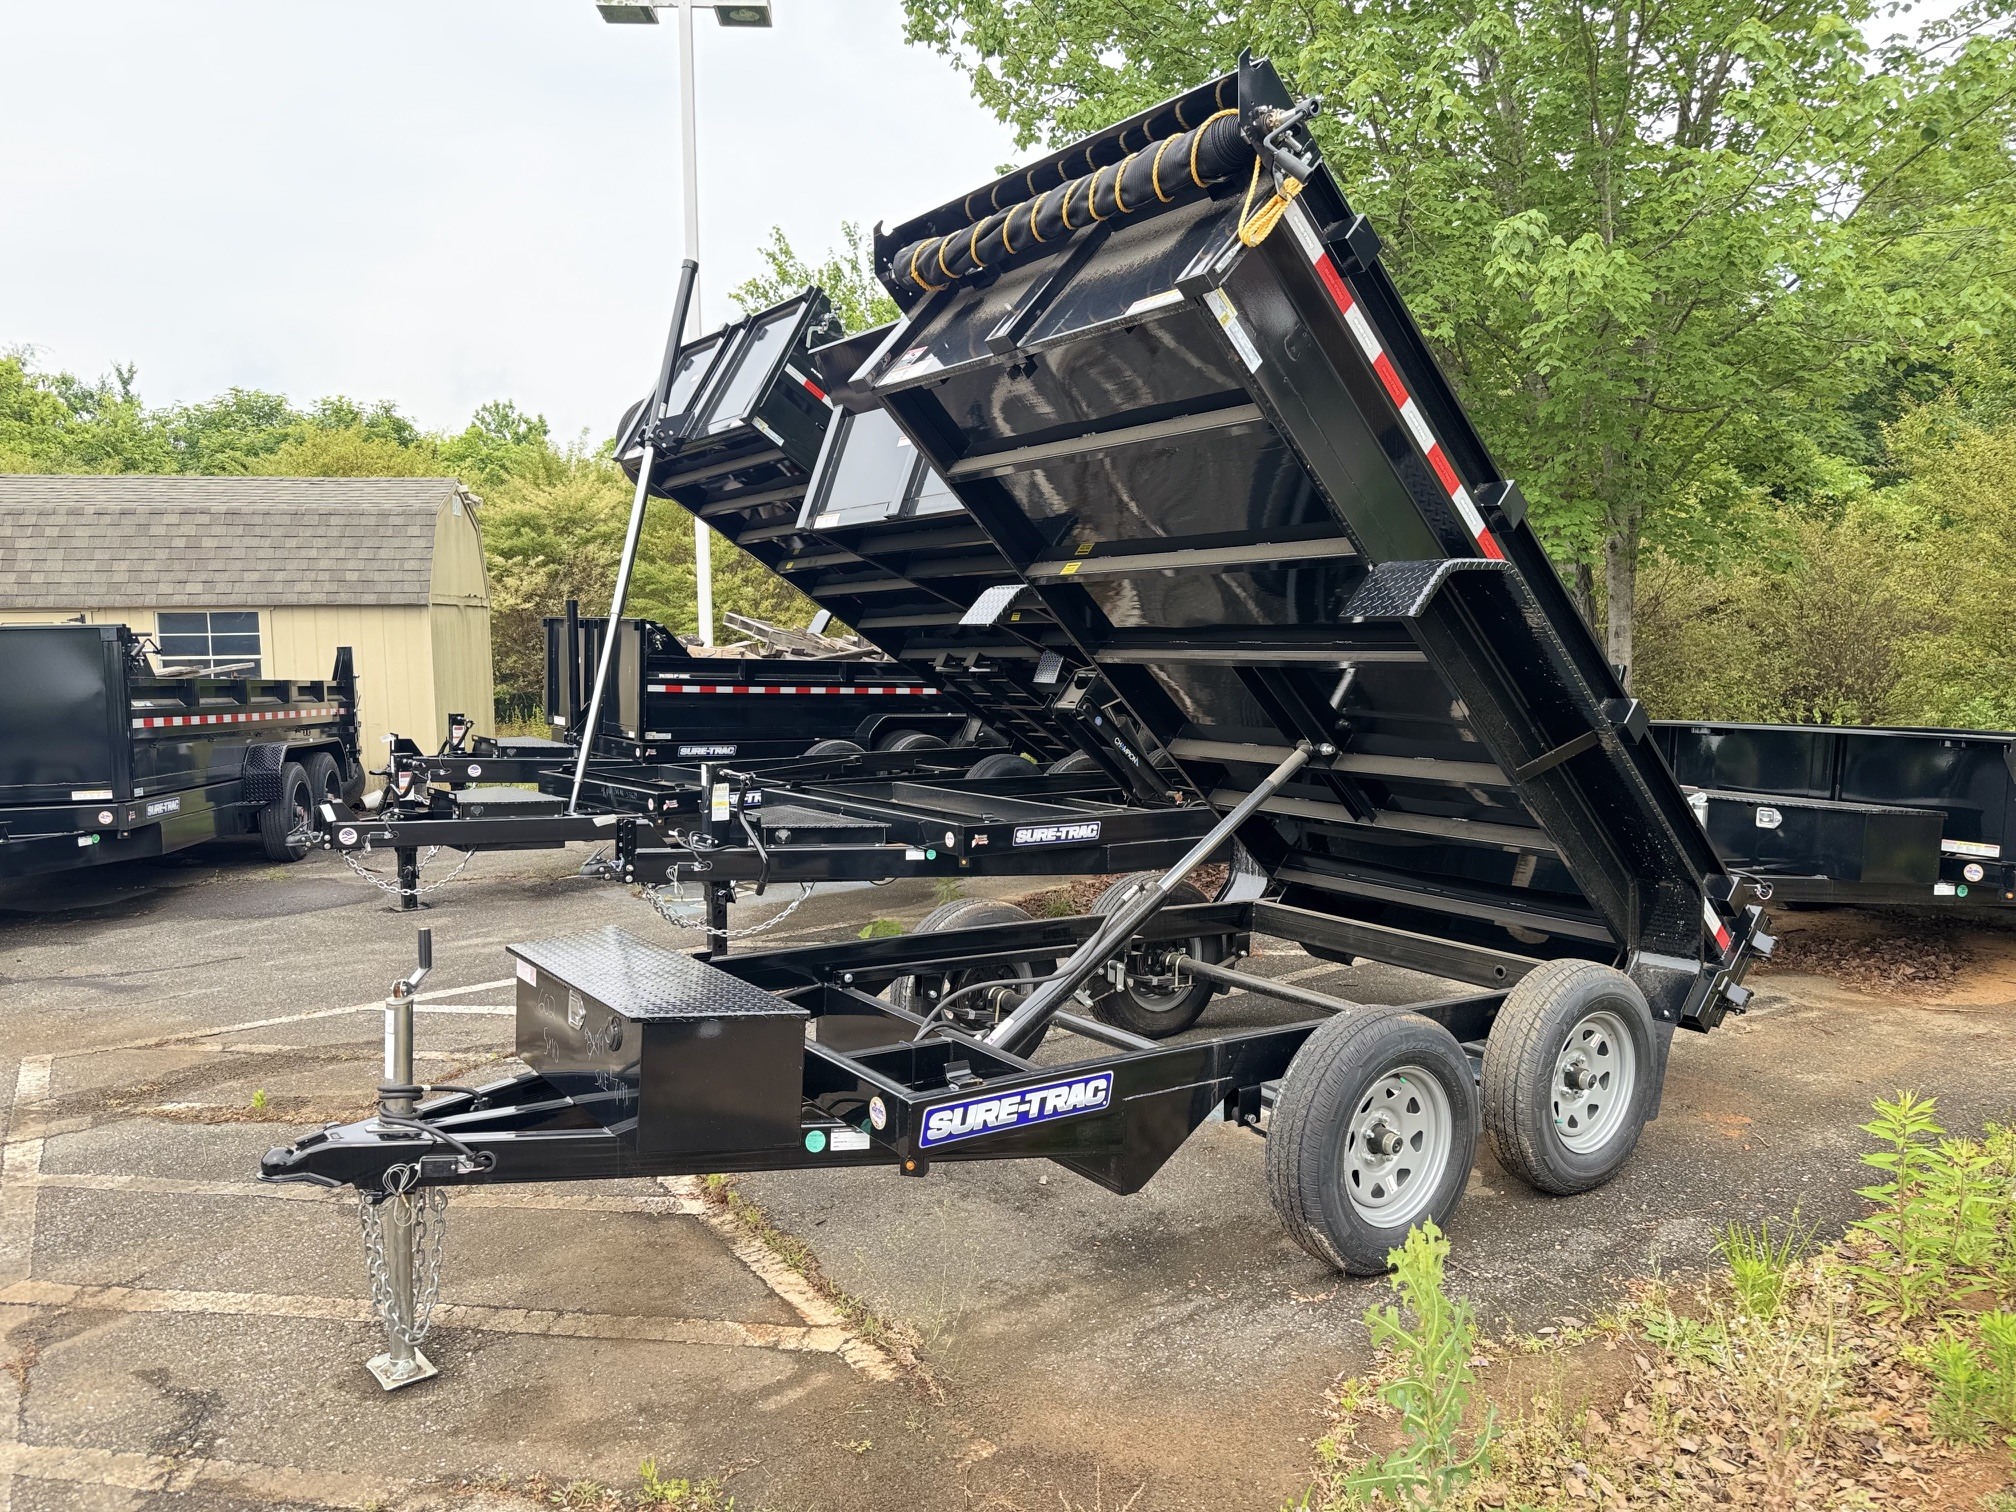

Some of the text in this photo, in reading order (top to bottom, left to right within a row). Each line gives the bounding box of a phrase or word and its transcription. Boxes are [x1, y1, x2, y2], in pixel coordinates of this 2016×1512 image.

[679, 746, 735, 757] SURE-TRAC
[147, 799, 180, 817] SURE-TRAC
[1015, 824, 1098, 843] SURE-TRAC
[926, 1078, 1108, 1140] SURE-TRAC
